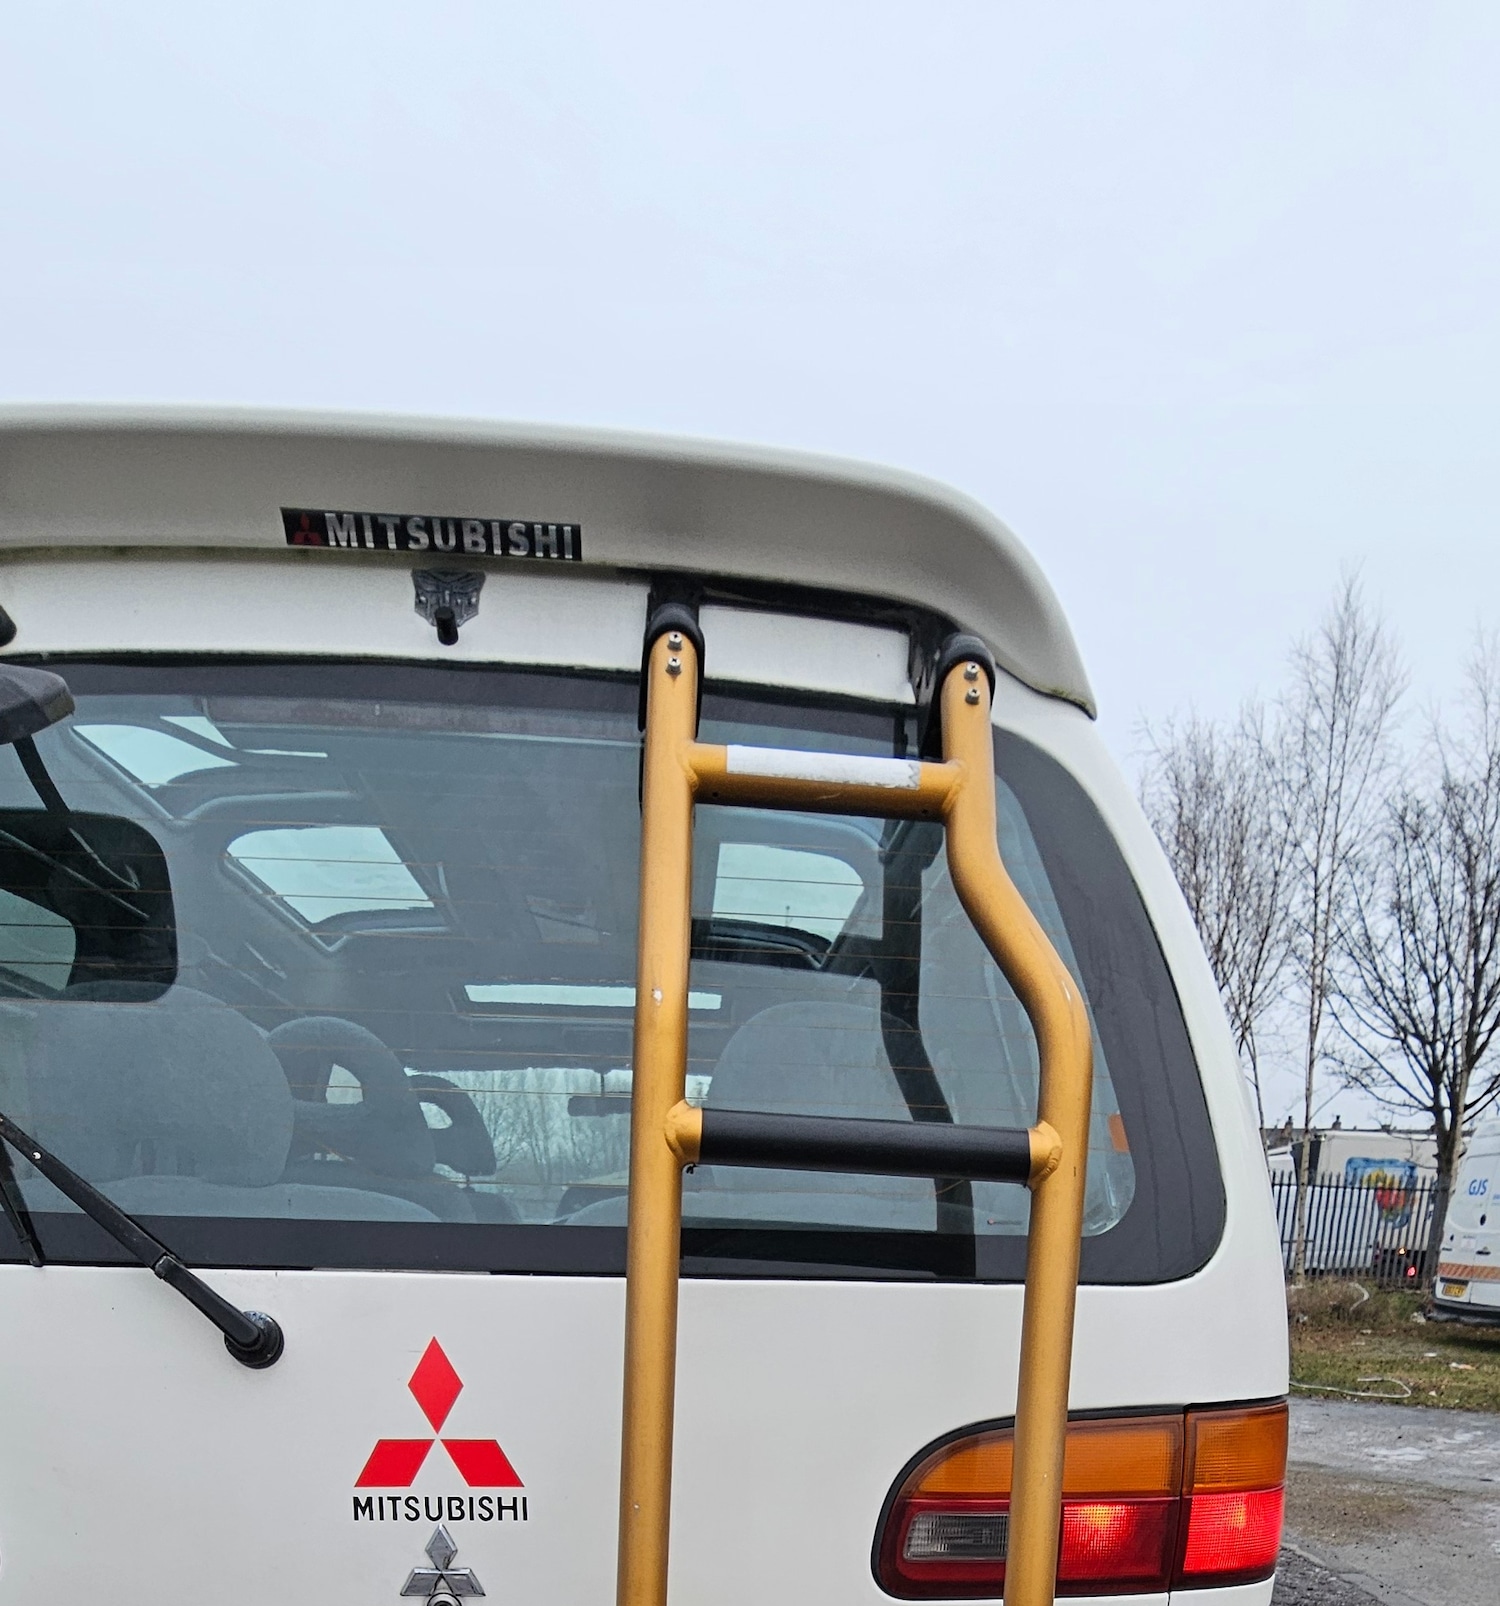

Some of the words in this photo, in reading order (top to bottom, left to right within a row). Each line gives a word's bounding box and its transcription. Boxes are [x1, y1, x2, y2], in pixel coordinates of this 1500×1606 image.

[324, 512, 573, 560] MITSUBISHI
[1469, 1179, 1488, 1196] GJS
[352, 1496, 528, 1521] MITSUBISHI
